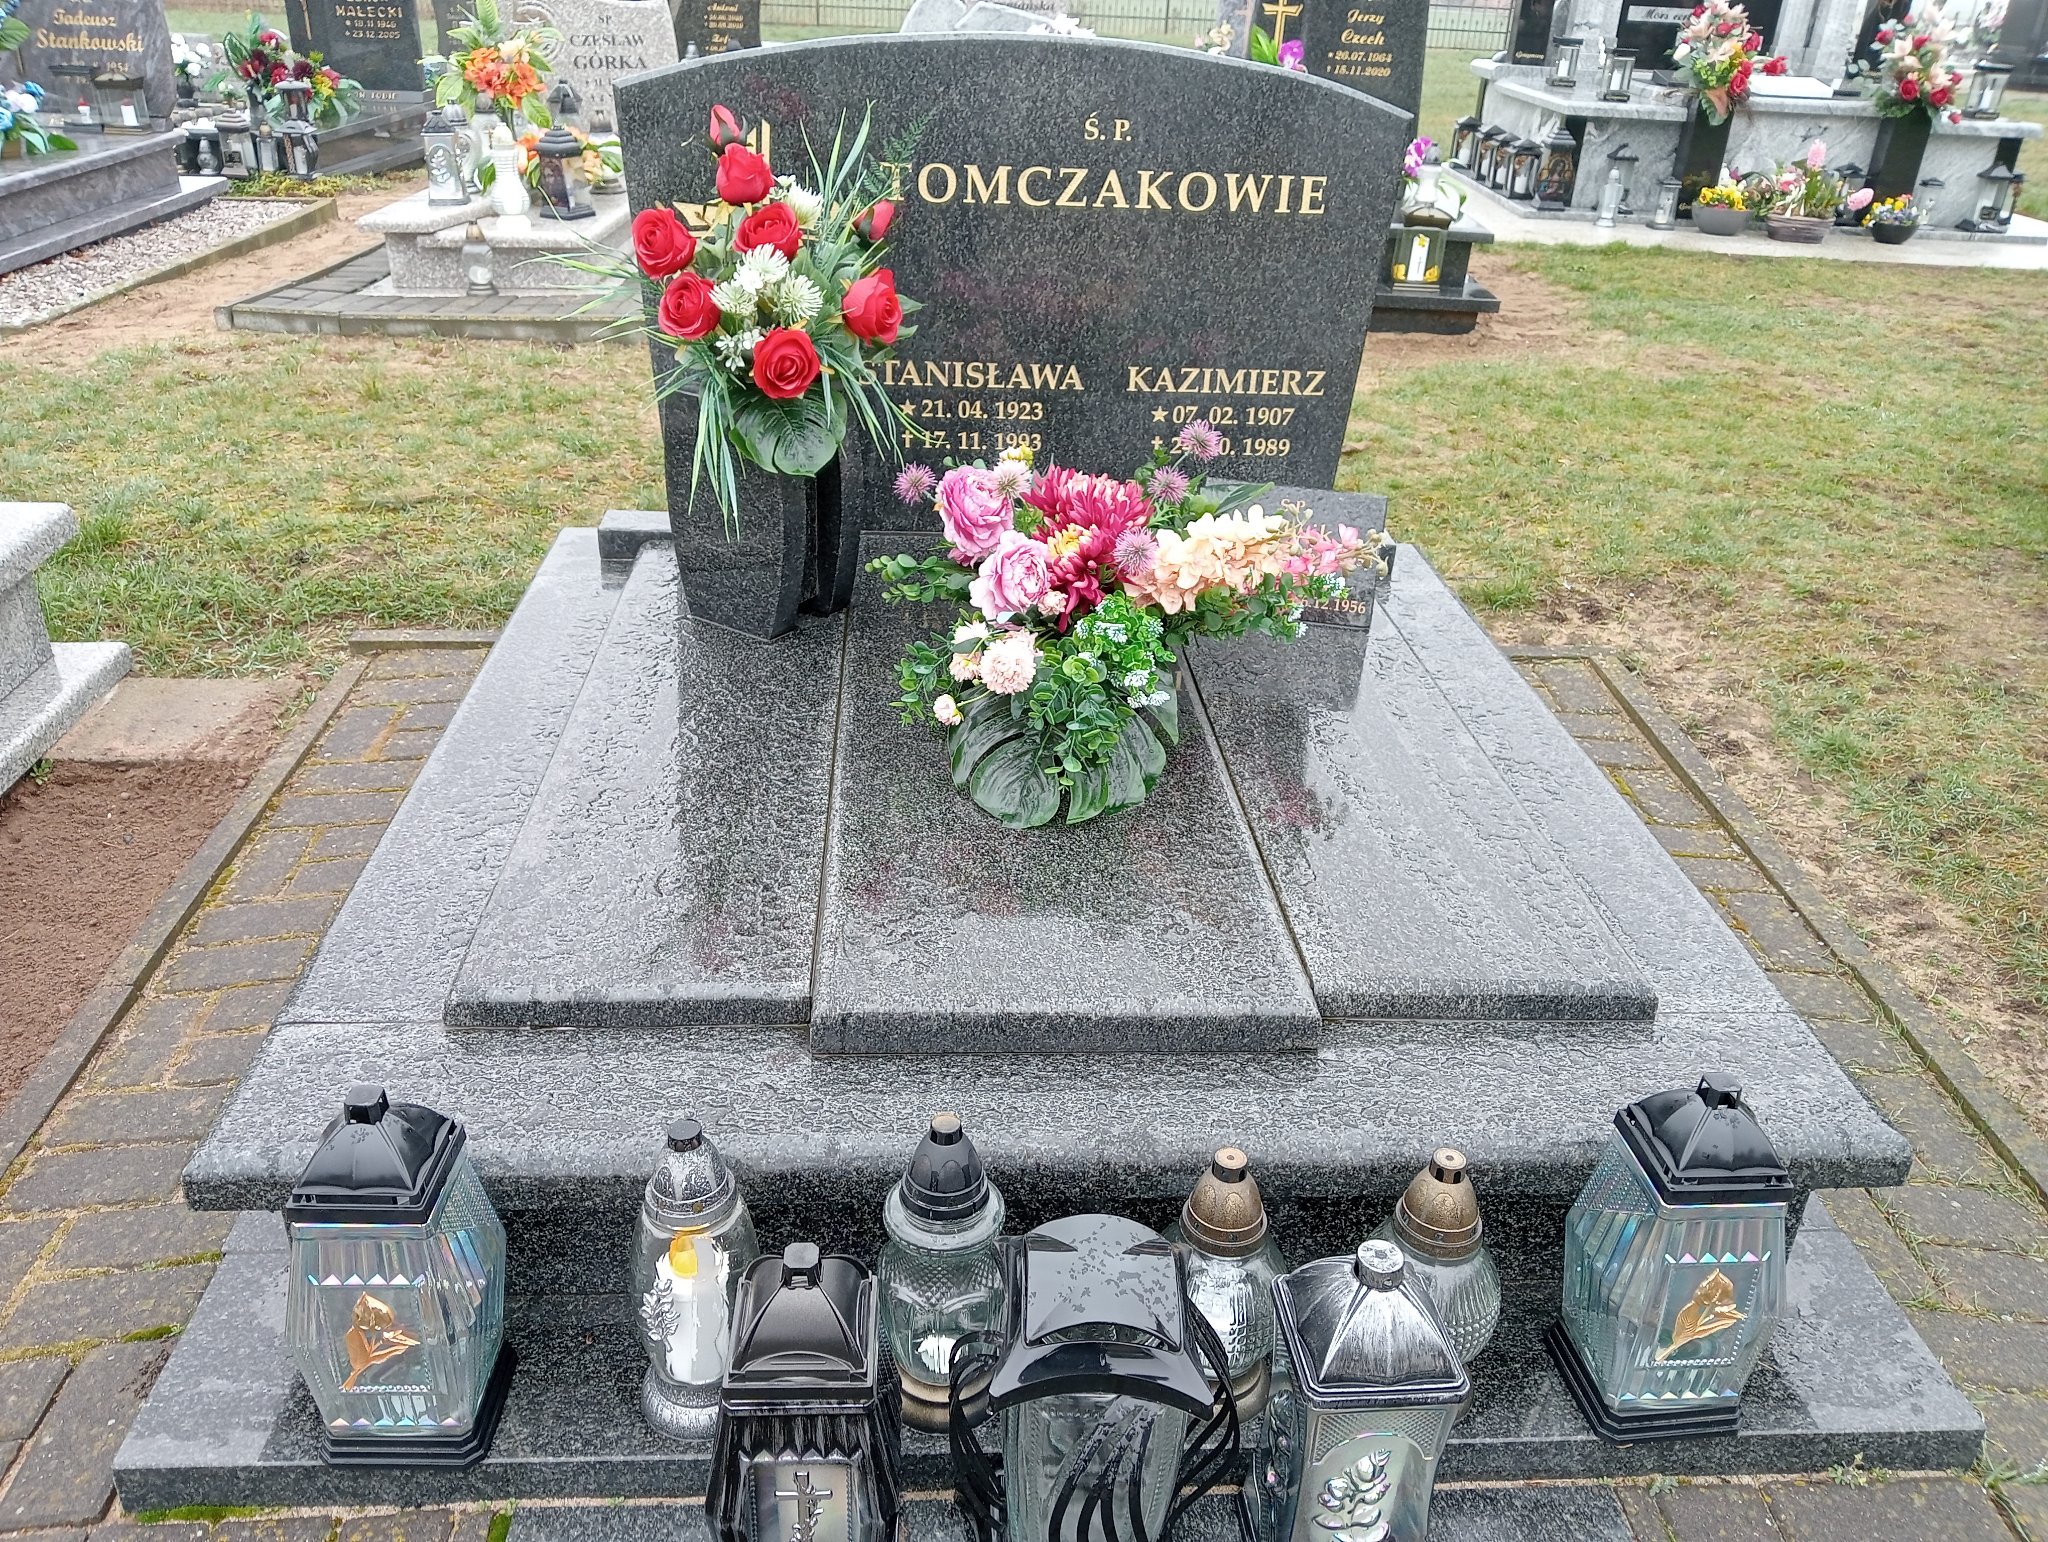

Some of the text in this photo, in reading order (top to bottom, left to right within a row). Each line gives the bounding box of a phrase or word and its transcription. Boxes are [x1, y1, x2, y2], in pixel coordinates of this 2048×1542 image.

[53, 9, 118, 27] Tadeusz
[335, 5, 403, 18] MAŁECKI
[1347, 9, 1385, 25] Jerzy
[37, 28, 144, 52] Stankowski
[1341, 28, 1385, 45] Czech
[573, 50, 648, 70] GÓRKA
[1084, 111, 1132, 142] Ś. P.
[879, 160, 1328, 216] TOMCZAKOWIE
[858, 359, 1085, 391] STANISŁAWA
[1126, 365, 1327, 396] KAZIMIERZ
[921, 399, 1044, 421] 21. 04. 1923
[1208, 406, 1239, 425] 02.
[1245, 406, 1296, 426] 1907
[958, 432, 988, 450] 11.
[994, 432, 1042, 451] 1993
[1242, 437, 1291, 457] 1989
